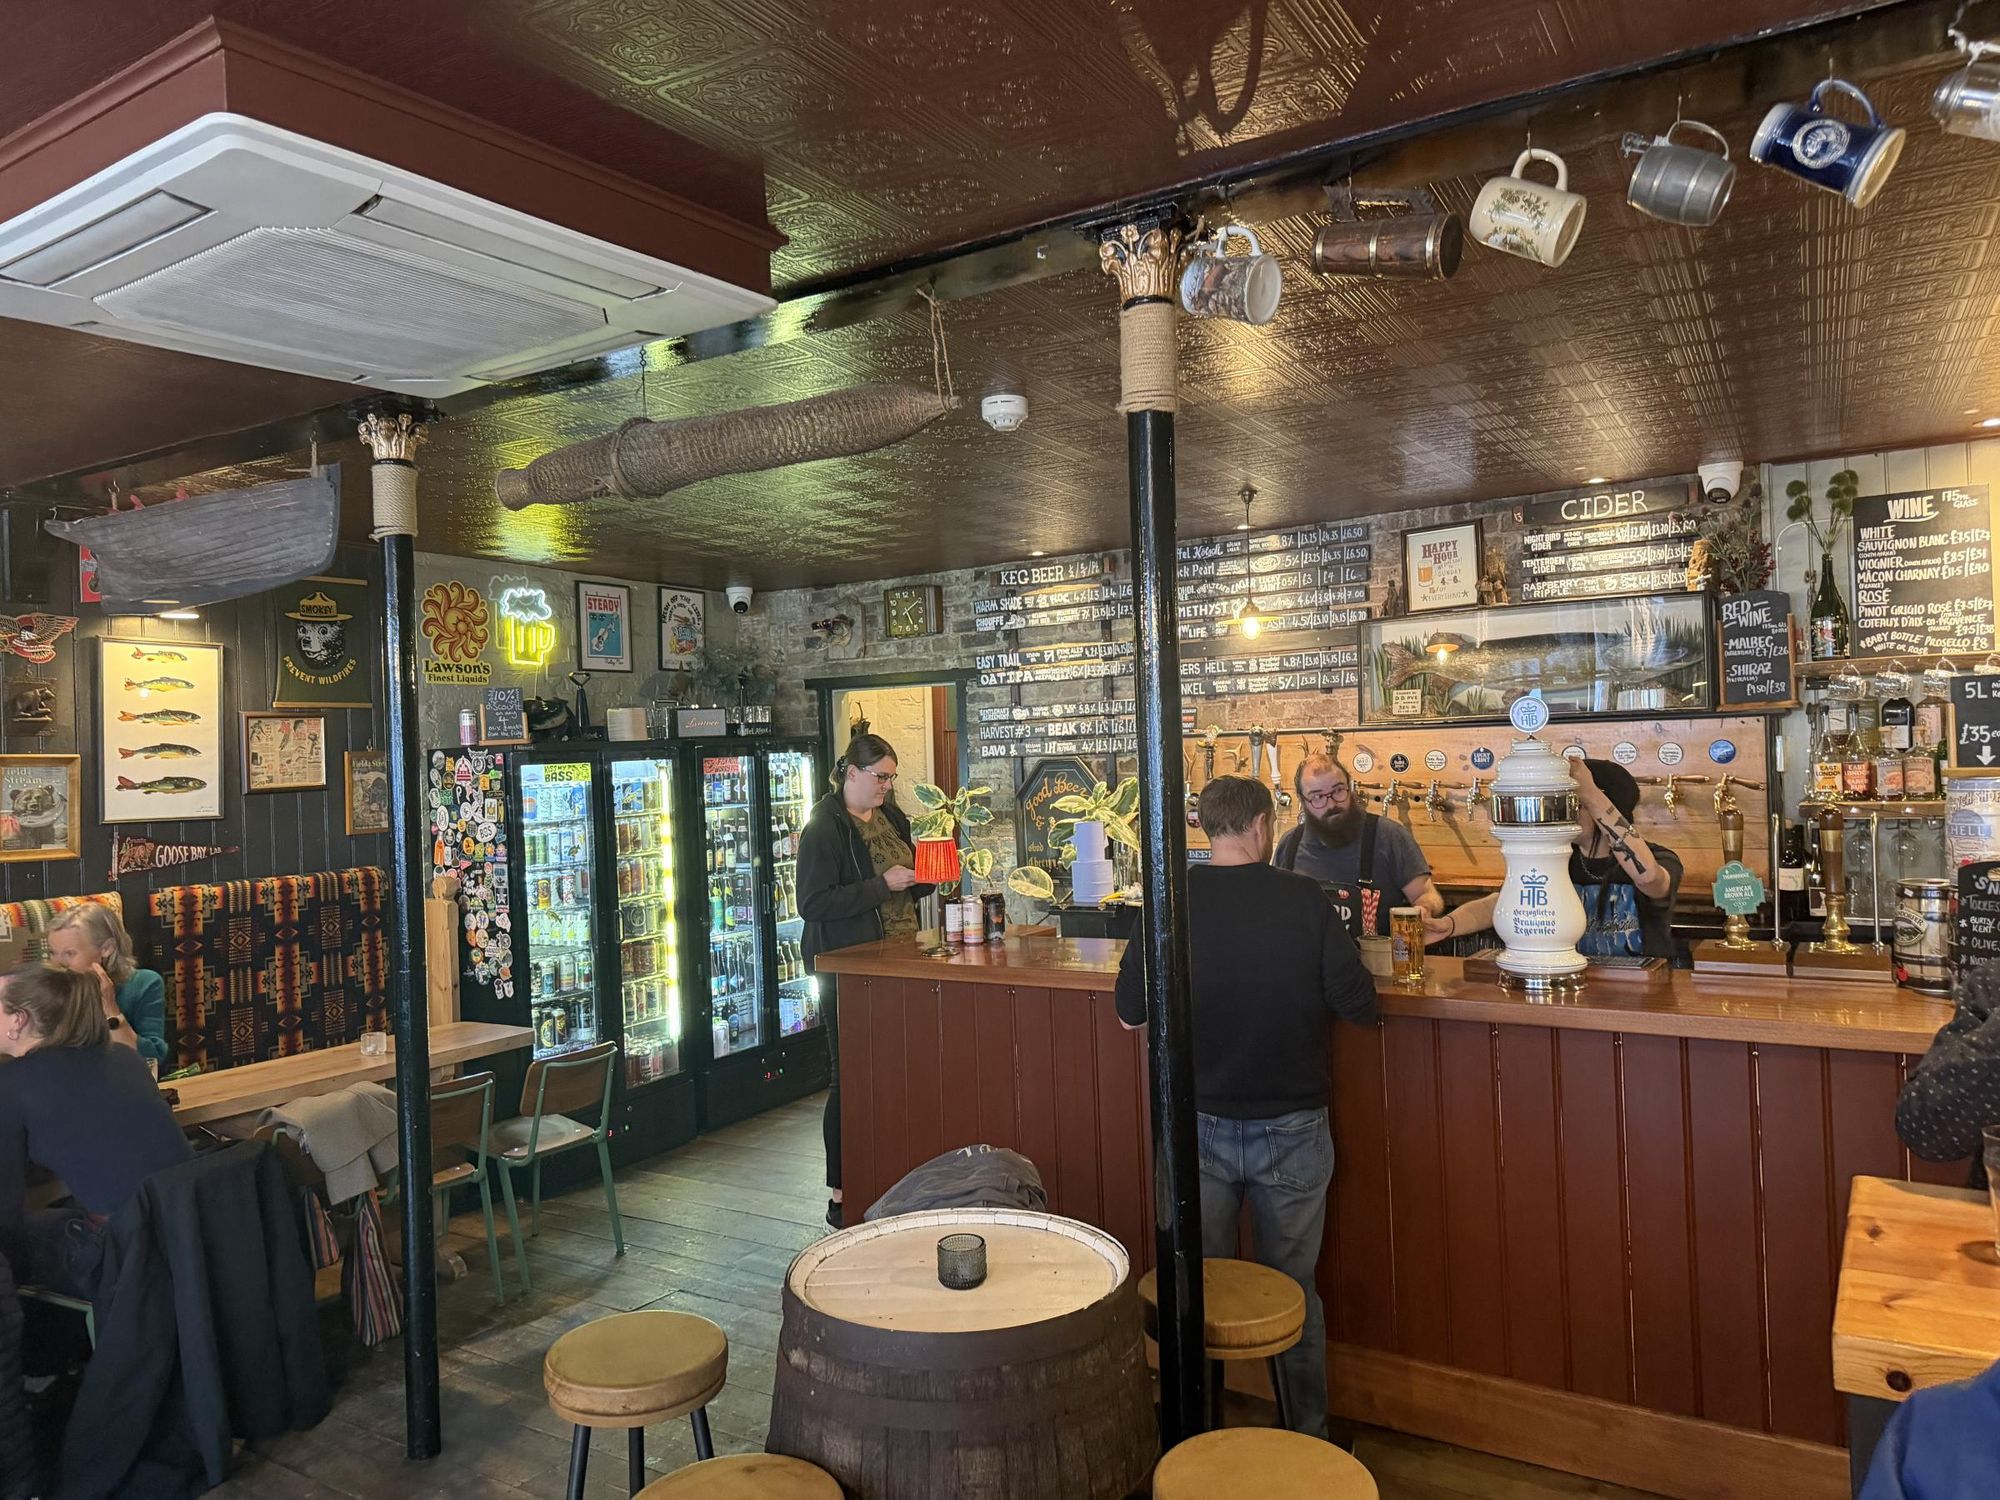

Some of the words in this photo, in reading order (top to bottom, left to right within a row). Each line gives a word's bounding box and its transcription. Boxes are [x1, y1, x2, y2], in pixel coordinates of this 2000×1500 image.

[1561, 490, 1648, 520] CIDER
[1887, 496, 1934, 519] WINE
[1953, 498, 1979, 508] GLASS
[1343, 527, 1362, 539] £6.50
[1524, 535, 1544, 545] NIGHT
[1545, 532, 1561, 543] BIRD
[1860, 525, 1896, 540] WHITE
[1422, 540, 1458, 559] HAPPY
[1531, 541, 1551, 551] CIDER
[1857, 537, 1917, 552] SAUVIGNON
[1919, 533, 1949, 548] BLANC
[1192, 562, 1214, 576] Pearl
[1285, 555, 1299, 567] 5%
[1347, 547, 1367, 560] £6.50
[1433, 551, 1458, 565] HOUR
[1522, 556, 1565, 569] TENTERDEN
[1857, 556, 1904, 571] VIOGNIER
[1000, 569, 1029, 585] KEG
[1032, 565, 1064, 584] BEER
[1532, 564, 1556, 574] CIDER
[1895, 567, 1941, 581] CHARNAY
[1231, 578, 1256, 594] LAGER
[1303, 573, 1313, 585] £3
[1345, 568, 1356, 581] £6
[1258, 574, 1281, 584] LUCKY
[1523, 579, 1579, 592] RASPBERRY
[1533, 587, 1570, 598] RIPPLE
[1858, 588, 1892, 604] ROSÉ
[301, 604, 333, 614] SMOKEY
[587, 597, 619, 612] STEADY
[975, 600, 998, 614] WARM
[1000, 597, 1023, 611] SHADE
[1178, 602, 1228, 618] METHYST
[1721, 600, 1751, 623] RED
[1858, 605, 1890, 618] PINOT
[1891, 604, 1925, 615] GRIGIO
[975, 616, 1004, 628] CHOUFFE
[1738, 606, 1773, 628] WINE
[1858, 618, 1900, 628] COTEAUX
[1189, 627, 1208, 638] LIFE
[1865, 632, 1889, 648] BABY
[1891, 631, 1923, 643] BOTTLE
[1972, 636, 1989, 650] £8
[1873, 642, 1896, 653] WHITE
[1896, 643, 1906, 652] OR
[425, 660, 491, 675] Lawson's
[976, 655, 995, 669] EASY
[997, 653, 1022, 667] TRAIL
[1205, 661, 1227, 674] HELL
[1283, 657, 1301, 668] 4.8%
[1305, 656, 1319, 666] £3.10
[1322, 654, 1337, 665] £4.15
[1342, 652, 1358, 664] £6.2
[283, 655, 316, 685] PREVENT
[318, 658, 357, 685] WILDFIRES
[428, 674, 454, 684] Finest
[457, 674, 488, 685] Liquids
[1181, 683, 1205, 695] NKEL
[1280, 676, 1295, 689] 5%
[494, 688, 515, 703] 10%
[1965, 681, 1988, 699] 5L
[486, 702, 523, 712] discount
[980, 726, 1015, 740] HARVEST
[1048, 722, 1077, 736] BEAK
[1080, 723, 1092, 734] 8%
[1959, 723, 1991, 745] £35
[981, 745, 1006, 757] BAVO
[7, 767, 27, 776] ield
[545, 771, 573, 782] BASS
[5, 775, 43, 785] Stream
[1026, 776, 1052, 821] good
[1035, 815, 1045, 831] &
[1950, 824, 1985, 836] HELL
[155, 845, 189, 868] GOOSE
[1520, 885, 1548, 909] HTB
[1725, 885, 1752, 894] AMERICAN
[1513, 926, 1556, 936] Tegernsee
[1972, 924, 1993, 933] KENT
